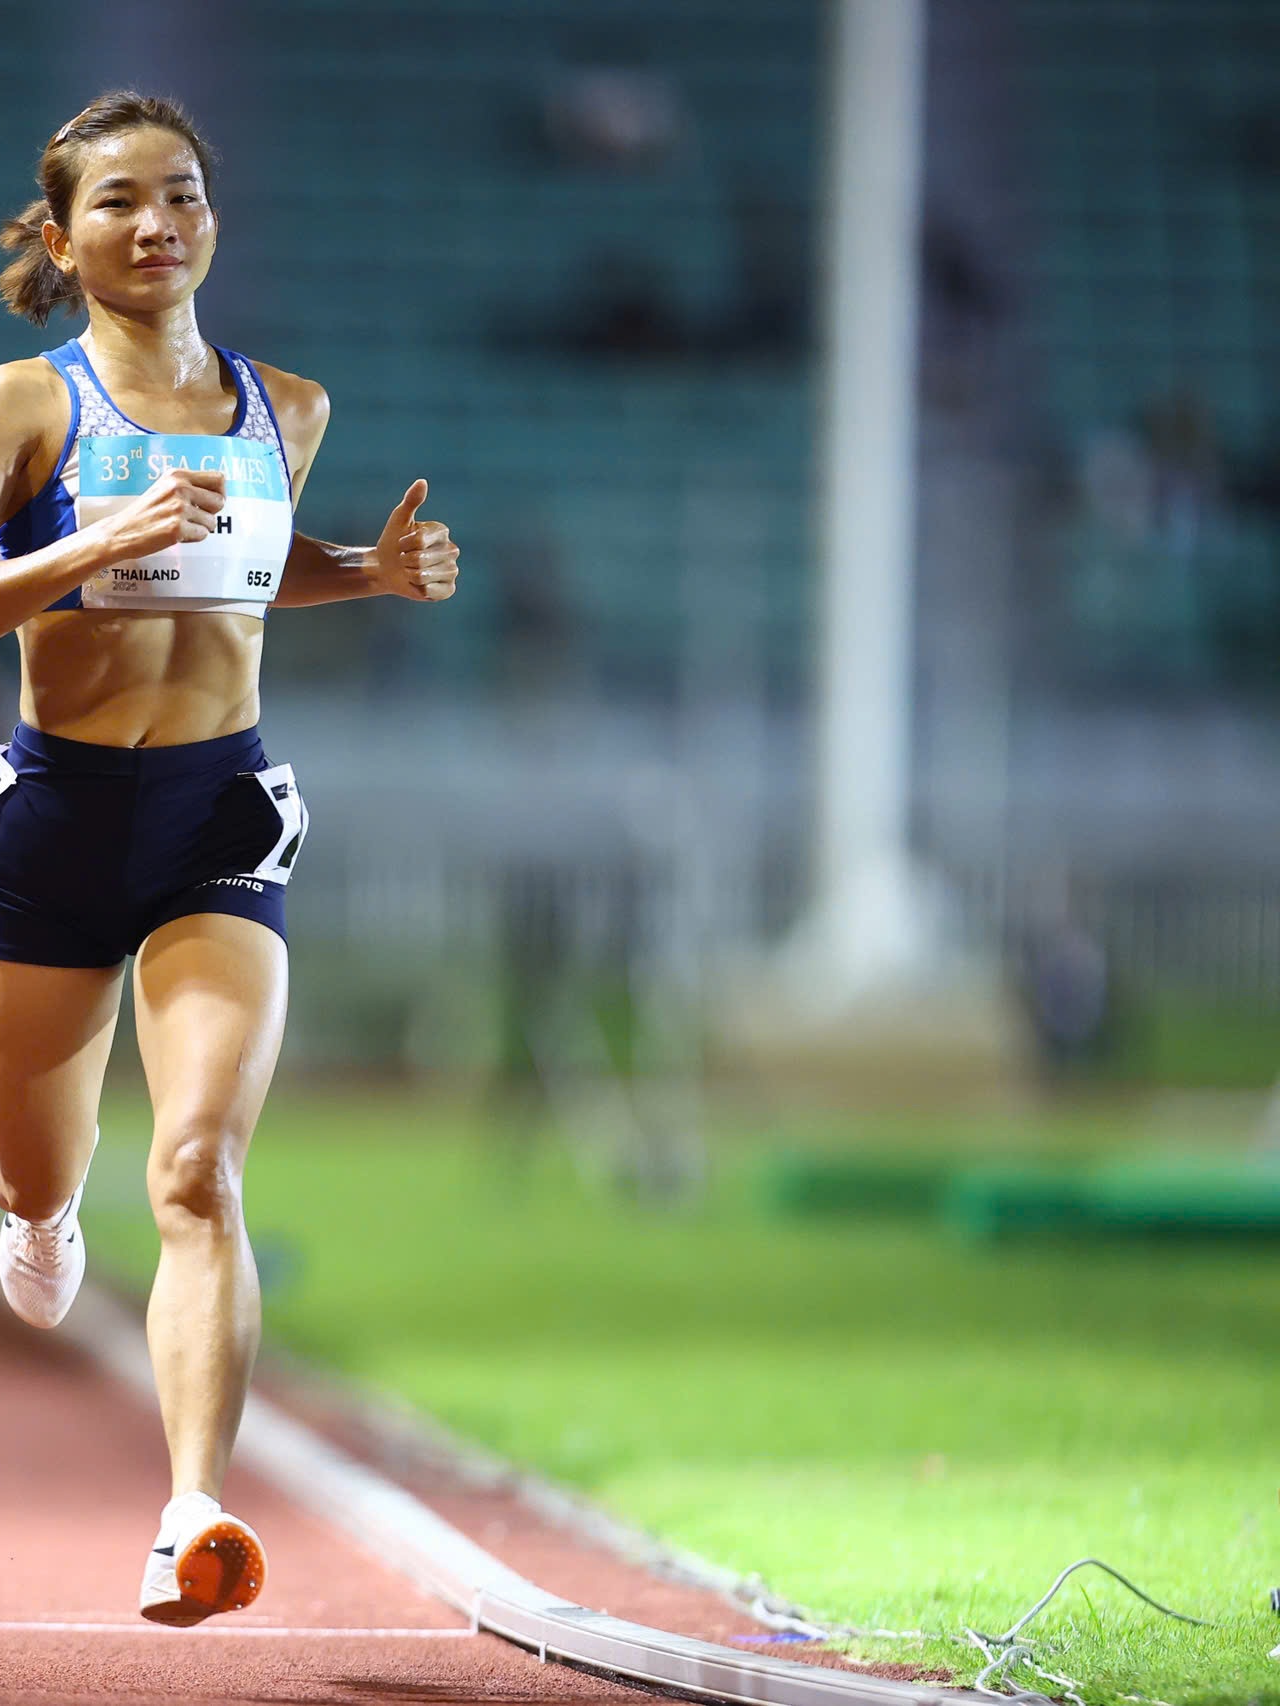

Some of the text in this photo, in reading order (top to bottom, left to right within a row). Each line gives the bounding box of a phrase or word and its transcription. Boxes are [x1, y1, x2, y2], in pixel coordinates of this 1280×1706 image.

[147, 454, 190, 480] SEA
[200, 455, 265, 484] GAMES
[111, 568, 180, 581] THAILAND
[247, 570, 272, 587] 652
